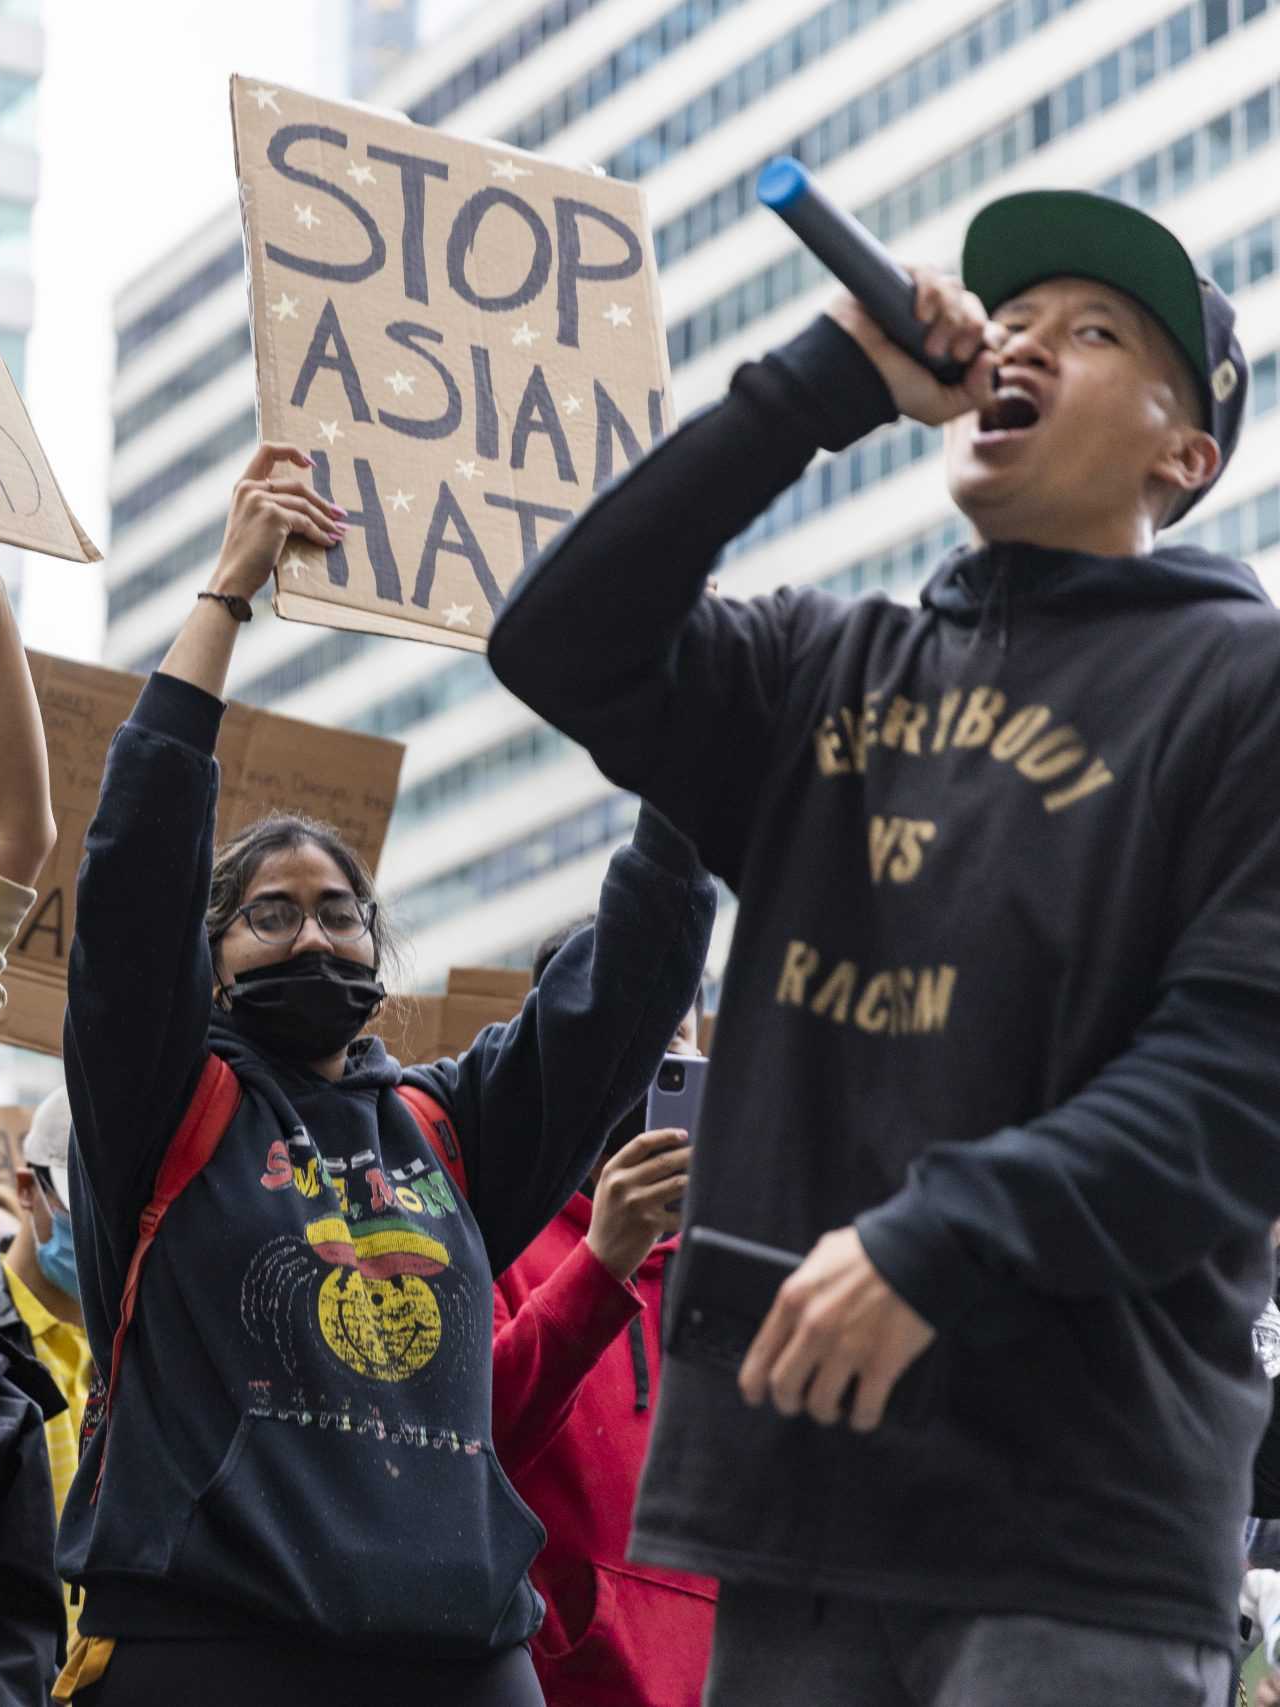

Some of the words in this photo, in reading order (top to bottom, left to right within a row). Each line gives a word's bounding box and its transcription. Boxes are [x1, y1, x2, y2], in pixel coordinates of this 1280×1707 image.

[265, 123, 643, 349] STOP
[290, 297, 665, 493] ASIAN
[311, 449, 580, 620] HAT
[868, 815, 937, 886] VS
